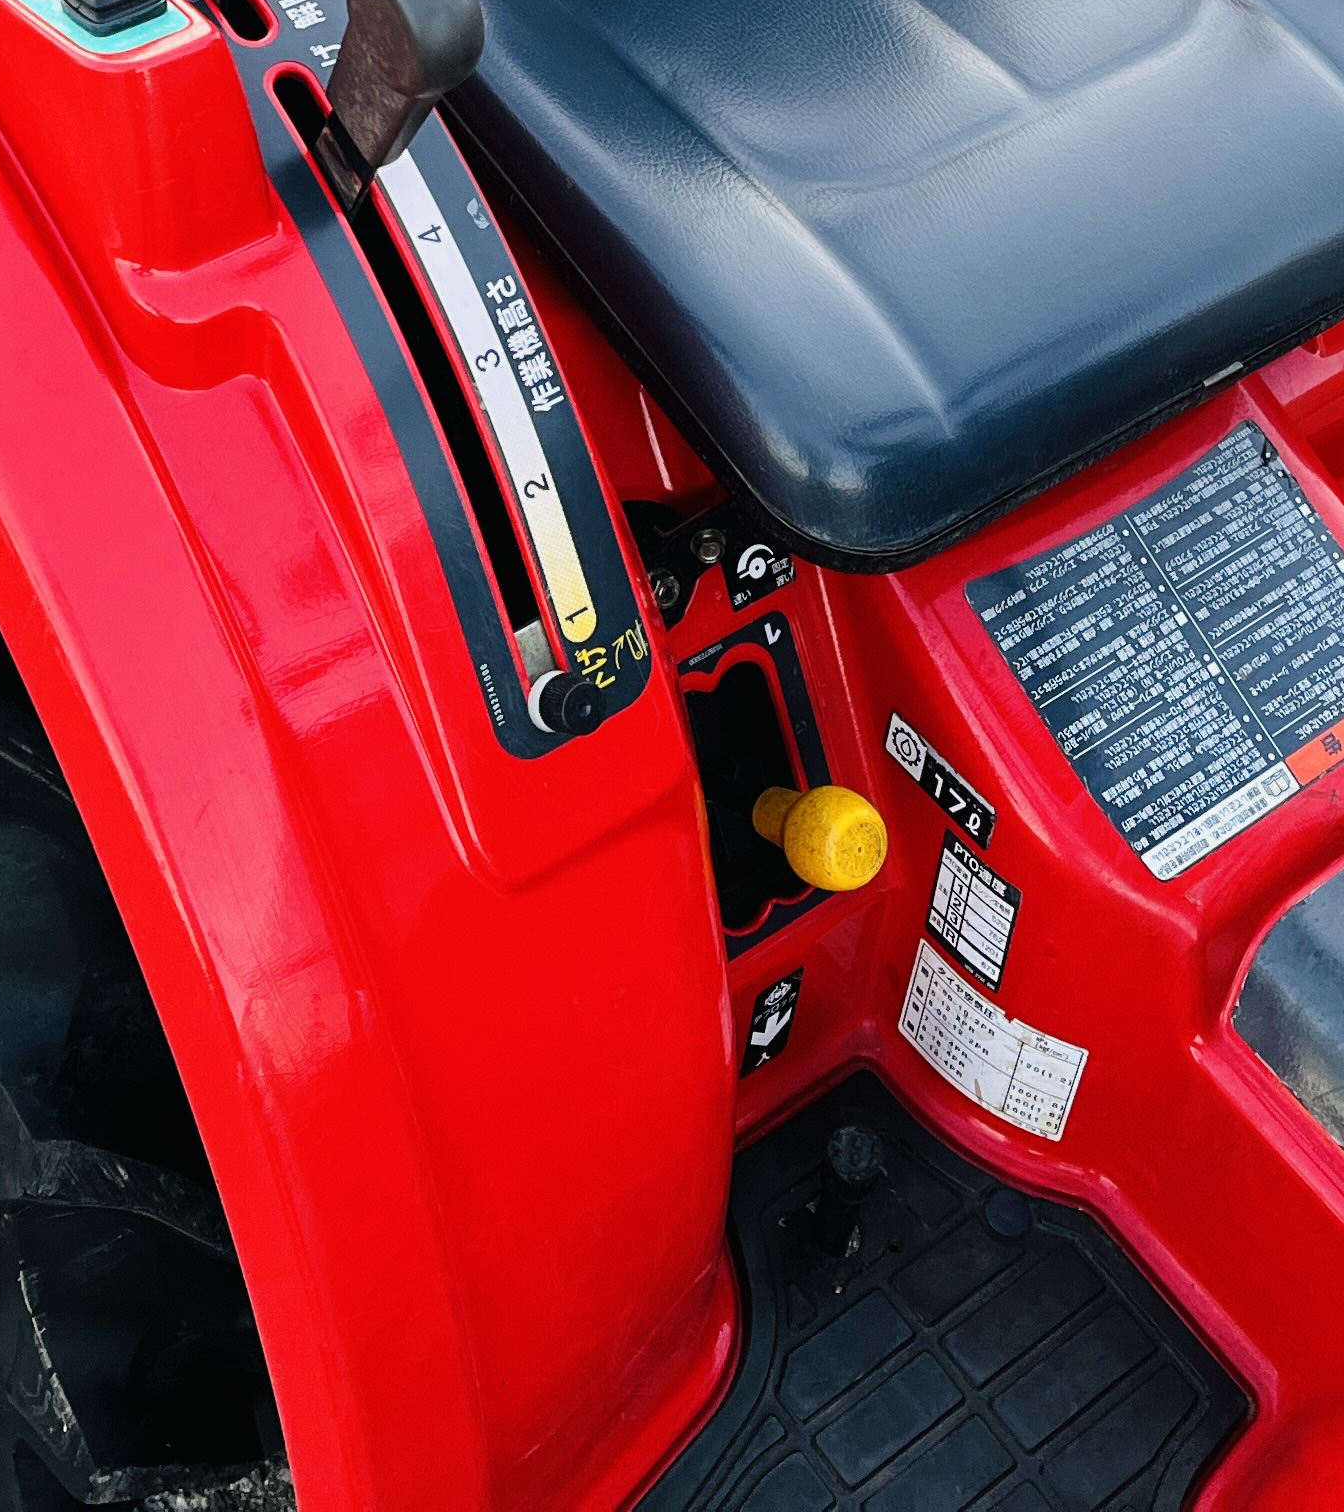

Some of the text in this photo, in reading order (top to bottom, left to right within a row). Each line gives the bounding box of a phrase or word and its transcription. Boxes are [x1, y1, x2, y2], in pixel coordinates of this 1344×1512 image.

[417, 223, 443, 244] 4
[485, 274, 565, 414] 作業機高さ
[474, 348, 501, 373] 3
[523, 472, 550, 500] 2
[564, 606, 589, 625] 1
[1162, 666, 1211, 704] 停止する時は
[957, 882, 965, 896] 1
[952, 897, 1004, 944] 2 762
[945, 928, 957, 946] R
[950, 911, 1000, 960] 3 1201
[937, 966, 994, 1021] タイヤ空気圧
